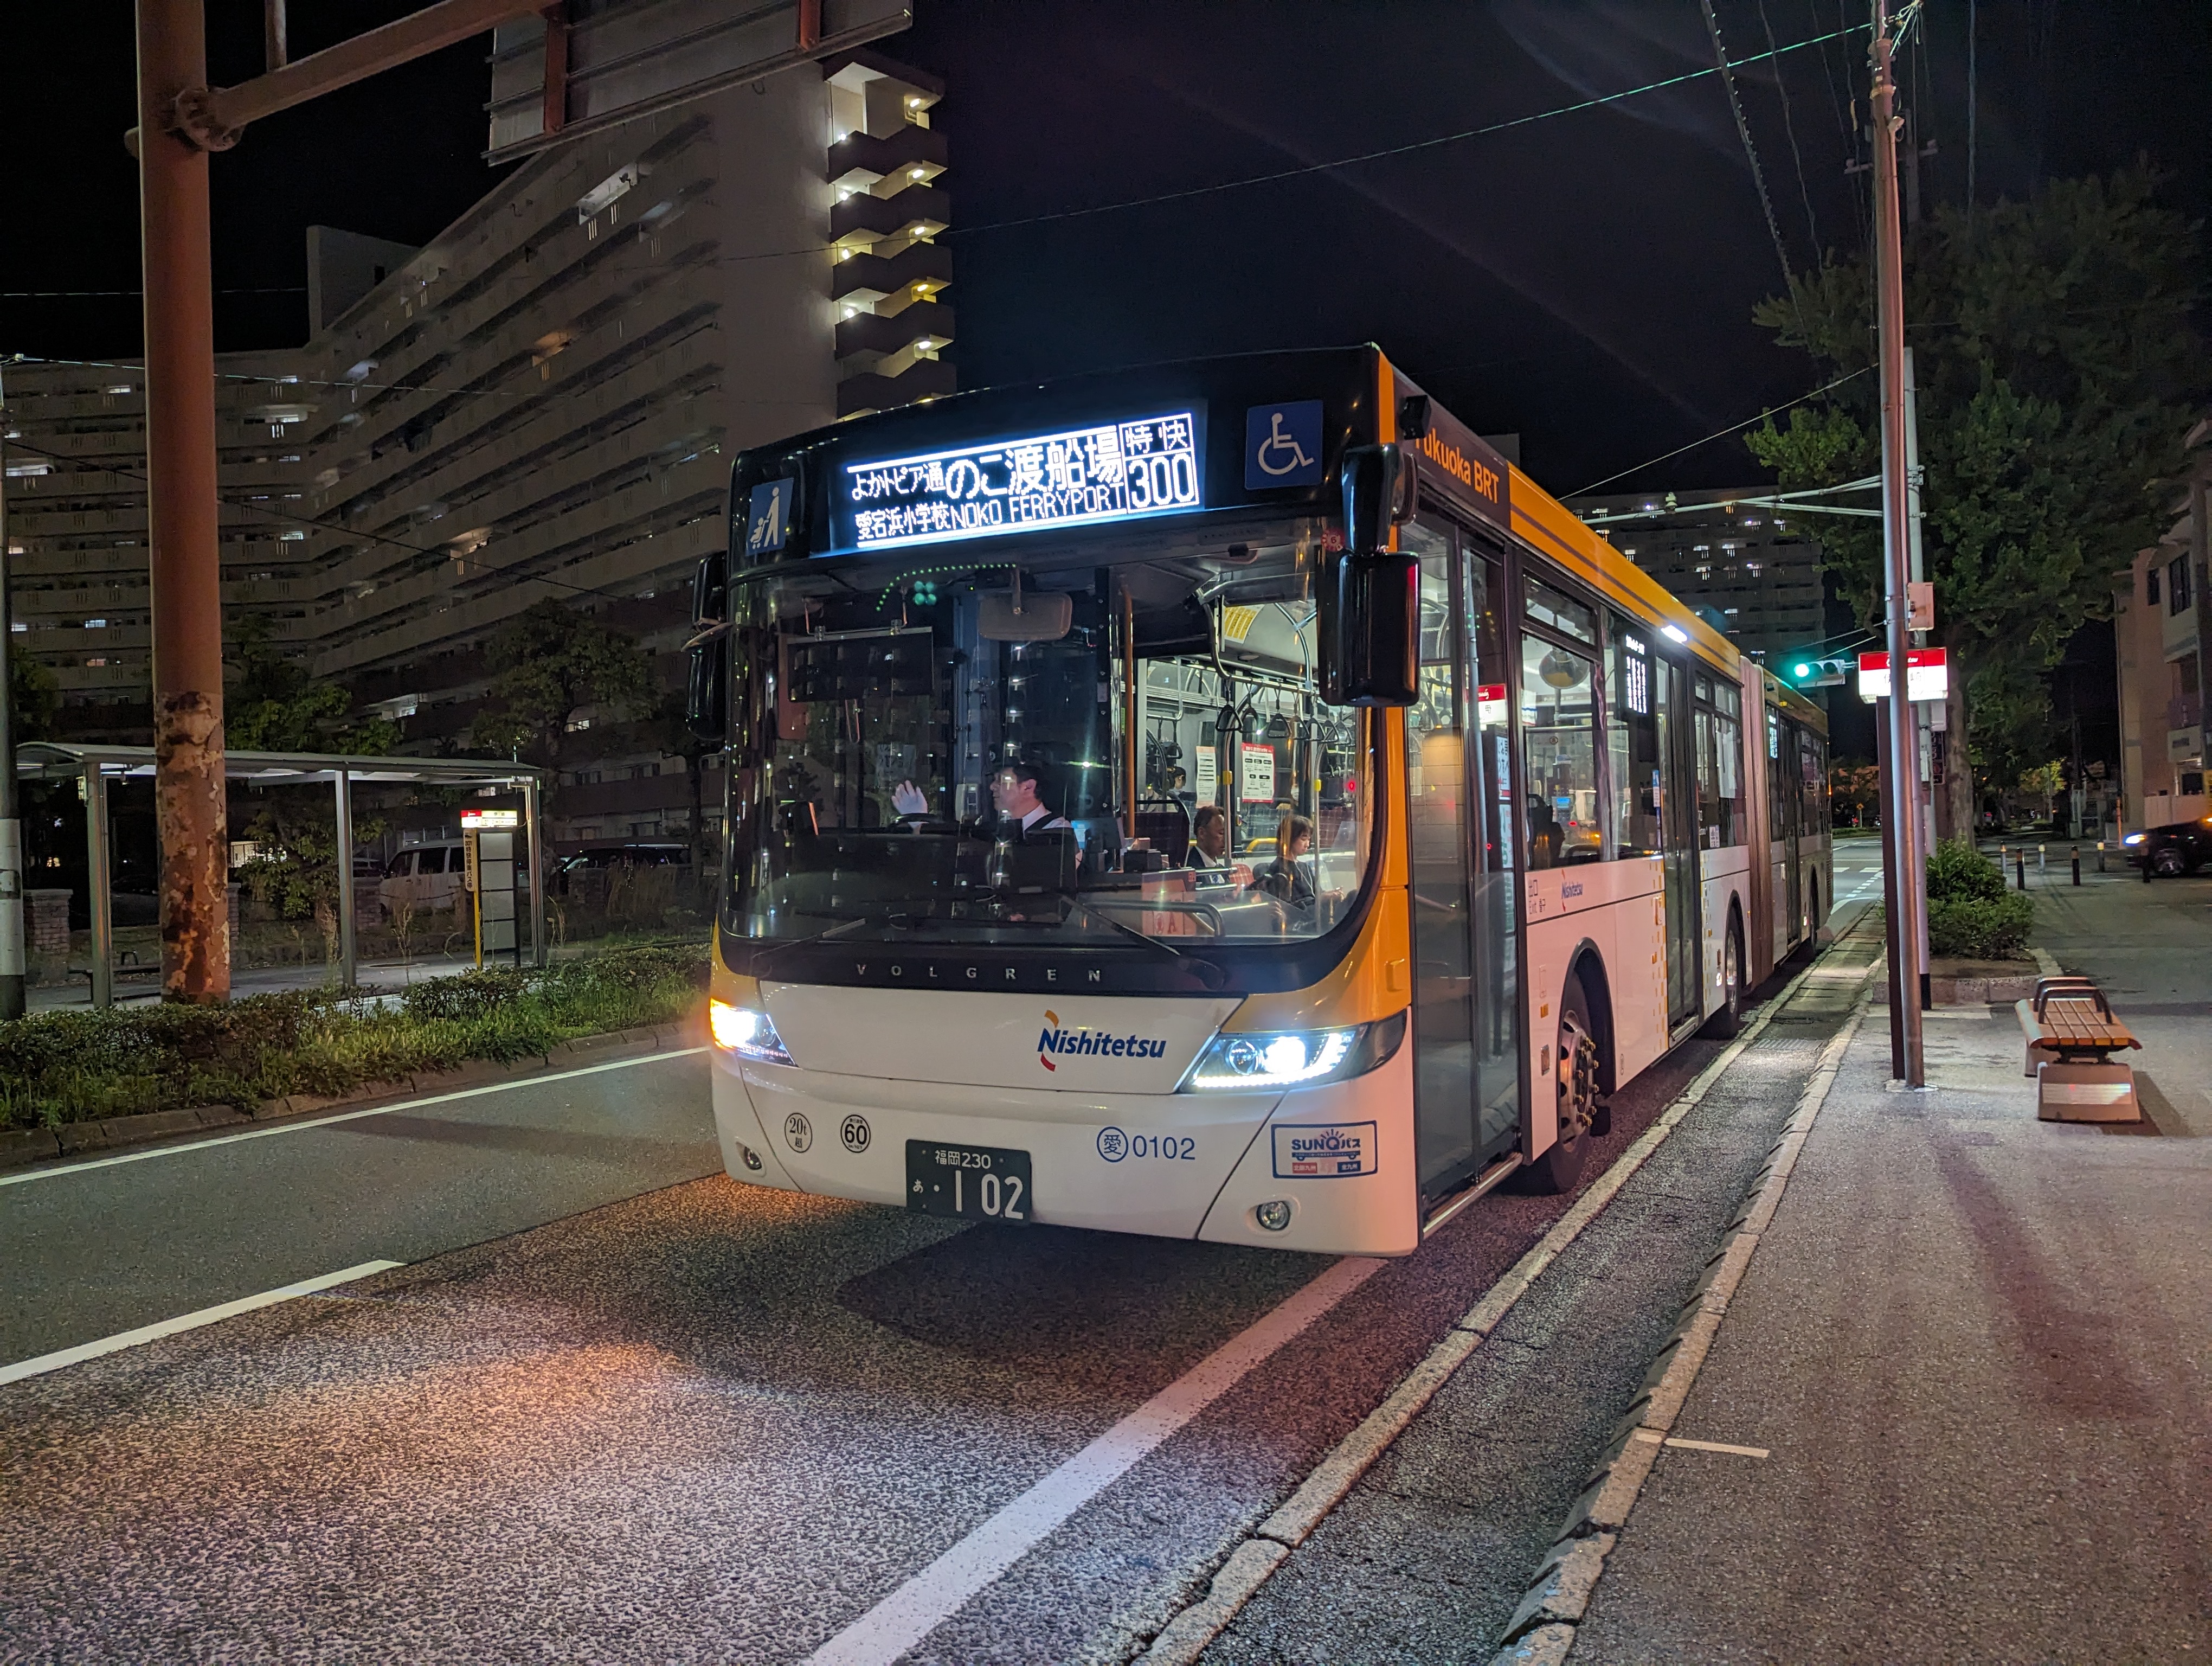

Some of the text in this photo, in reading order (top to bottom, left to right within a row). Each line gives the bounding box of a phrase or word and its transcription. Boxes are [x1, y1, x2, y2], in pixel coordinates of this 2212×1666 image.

[1125, 420, 1188, 455] 特快
[946, 432, 1124, 499] のこ渡船場
[1128, 454, 1193, 509] 300
[1474, 459, 1499, 504] BRT
[951, 482, 1124, 530] NOKO FERRYPORT
[856, 964, 1101, 982] VOLGREN
[1037, 1027, 1167, 1058] Nishitetsu
[789, 1117, 807, 1136] 20t
[844, 1123, 867, 1145] 60
[1133, 1135, 1195, 1160] 0102
[912, 1179, 924, 1193] あ
